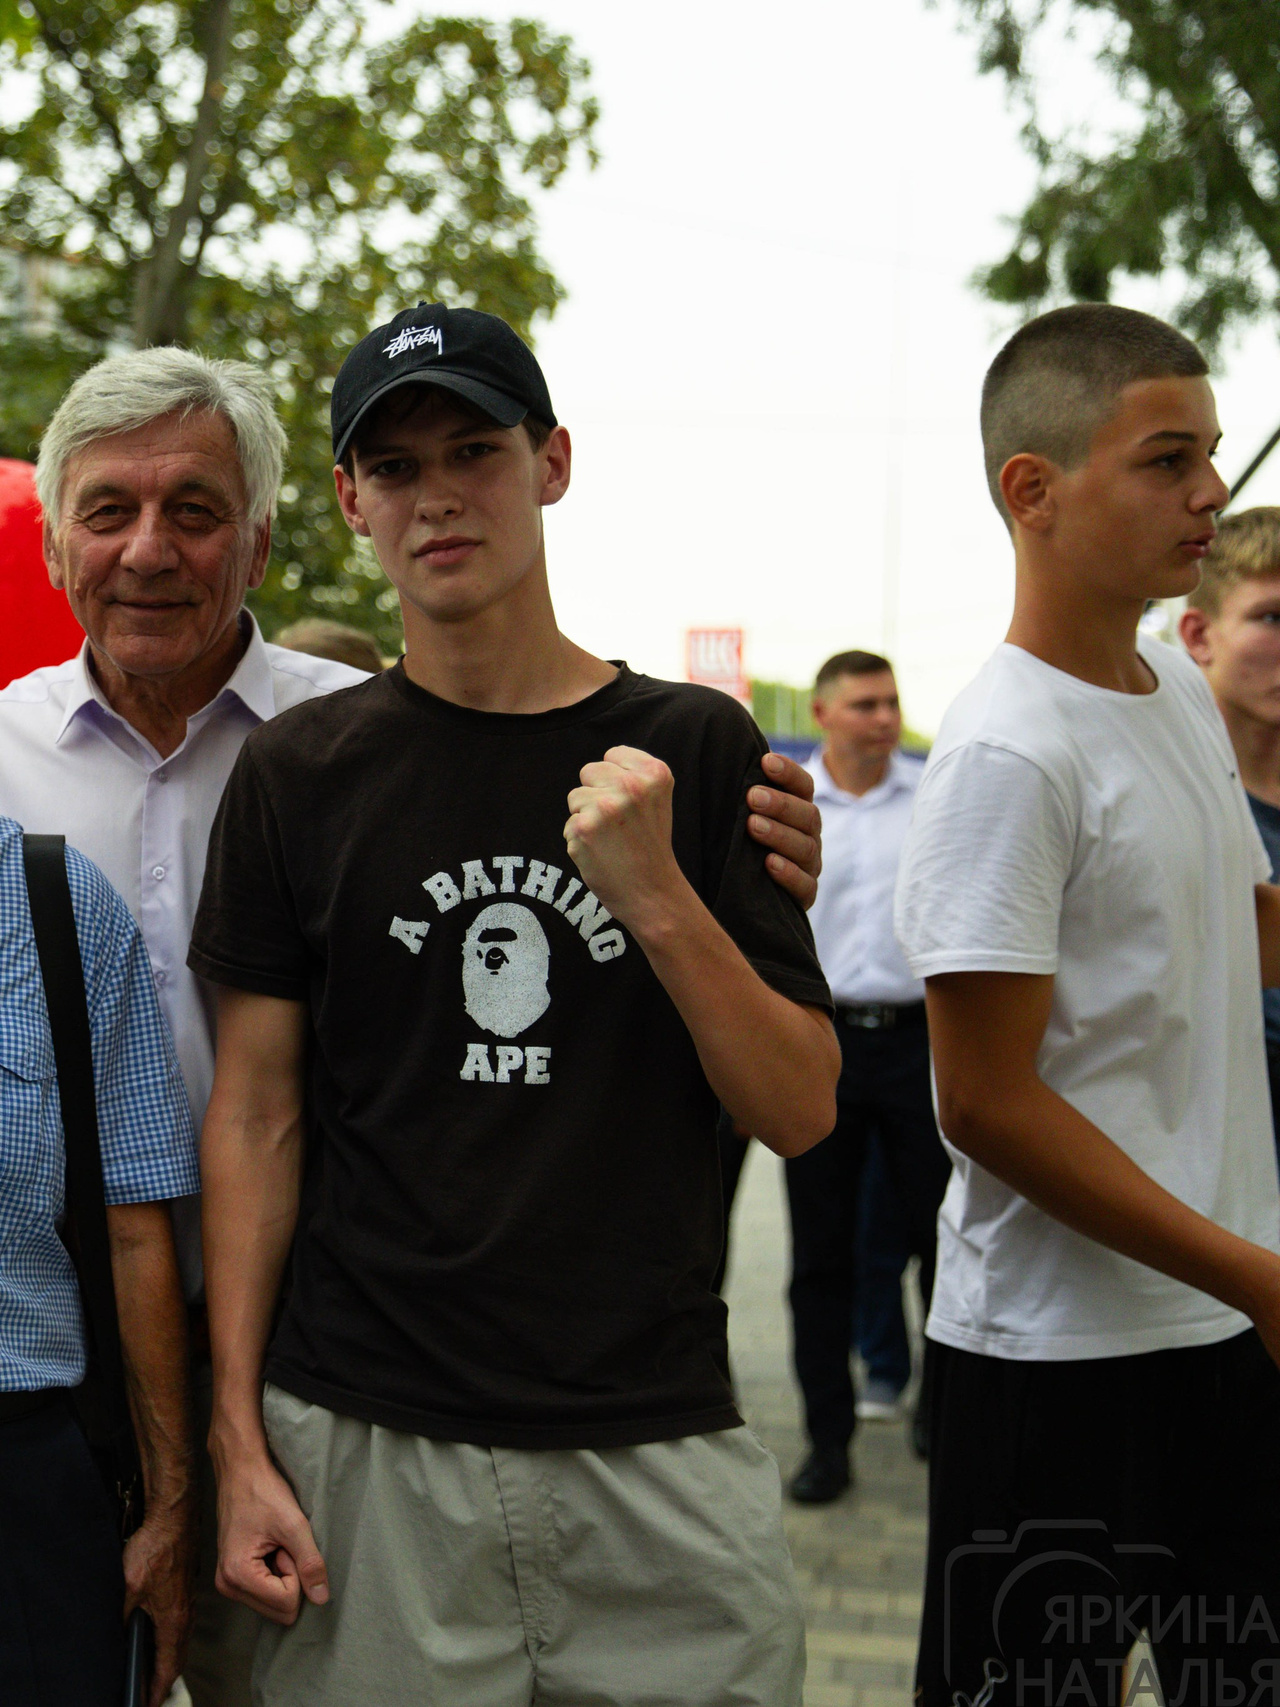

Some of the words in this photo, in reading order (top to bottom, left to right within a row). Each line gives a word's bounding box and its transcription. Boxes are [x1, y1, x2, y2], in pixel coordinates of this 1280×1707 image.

[388, 915, 431, 955] A
[421, 855, 627, 964] BATHING
[459, 1043, 552, 1085] APE
